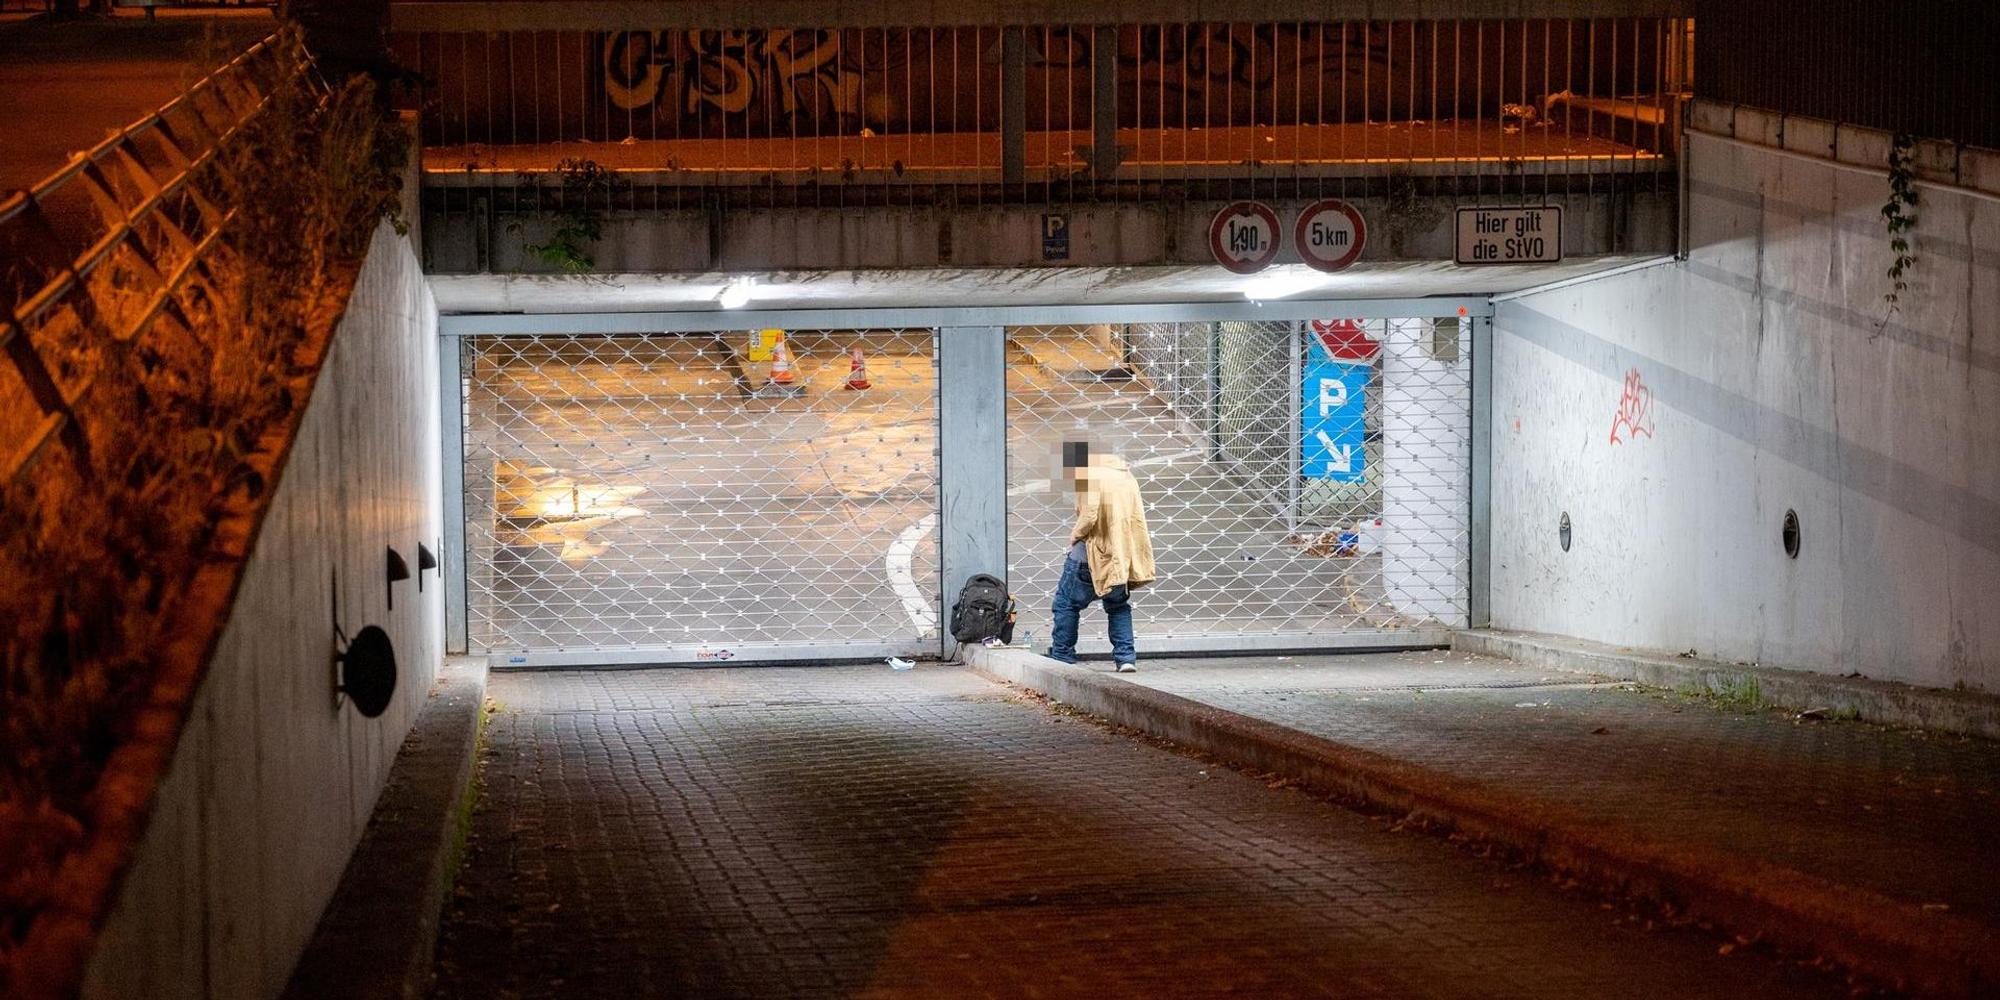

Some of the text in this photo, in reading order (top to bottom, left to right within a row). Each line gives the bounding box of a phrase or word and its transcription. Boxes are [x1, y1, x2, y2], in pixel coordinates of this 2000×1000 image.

[1047, 216, 1065, 237] P
[1312, 222, 1347, 246] 5 km
[1476, 211, 1541, 237] Hier gilt
[1473, 237, 1543, 259] die StVO
[1319, 378, 1347, 417] P
